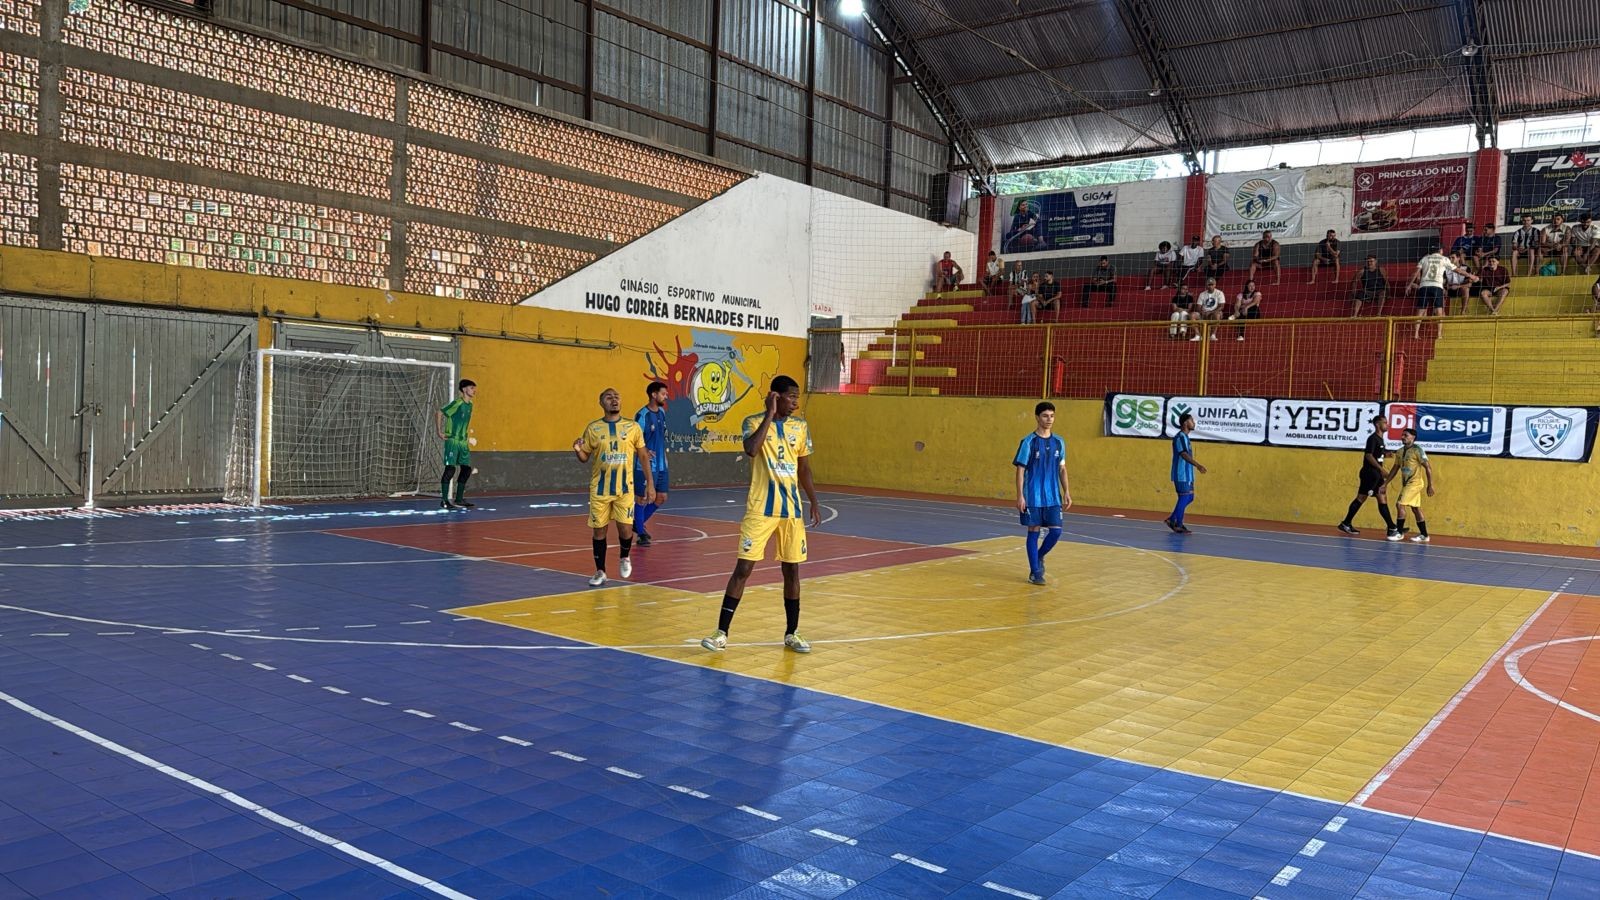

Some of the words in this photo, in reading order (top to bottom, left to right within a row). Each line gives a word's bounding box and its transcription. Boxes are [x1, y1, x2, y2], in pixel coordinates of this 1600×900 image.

[1378, 169, 1423, 179] PRINCESA
[1425, 167, 1439, 176] DO
[1441, 165, 1464, 174] NILO
[1220, 222, 1254, 232] SELECT
[1257, 220, 1288, 230] RURAL
[620, 277, 659, 295] GINÁSIO
[667, 286, 715, 302] ESPORTIVO
[721, 294, 761, 309] MUNICIPAL
[585, 292, 620, 312] HUGO
[626, 297, 669, 318] CORRÊA
[674, 304, 744, 327] BERNARDES
[747, 314, 779, 331] FILHO
[1115, 398, 1160, 429] ge
[1197, 407, 1249, 420] UNIFAA
[1285, 406, 1363, 432] YESU
[1219, 420, 1263, 429] UNIVERSITÁRIO
[1391, 414, 1414, 429] Di
[1419, 415, 1489, 437] Gaspi
[1285, 432, 1326, 440] MOBILIDADE
[609, 440, 619, 452] 14
[777, 445, 785, 460] 2
